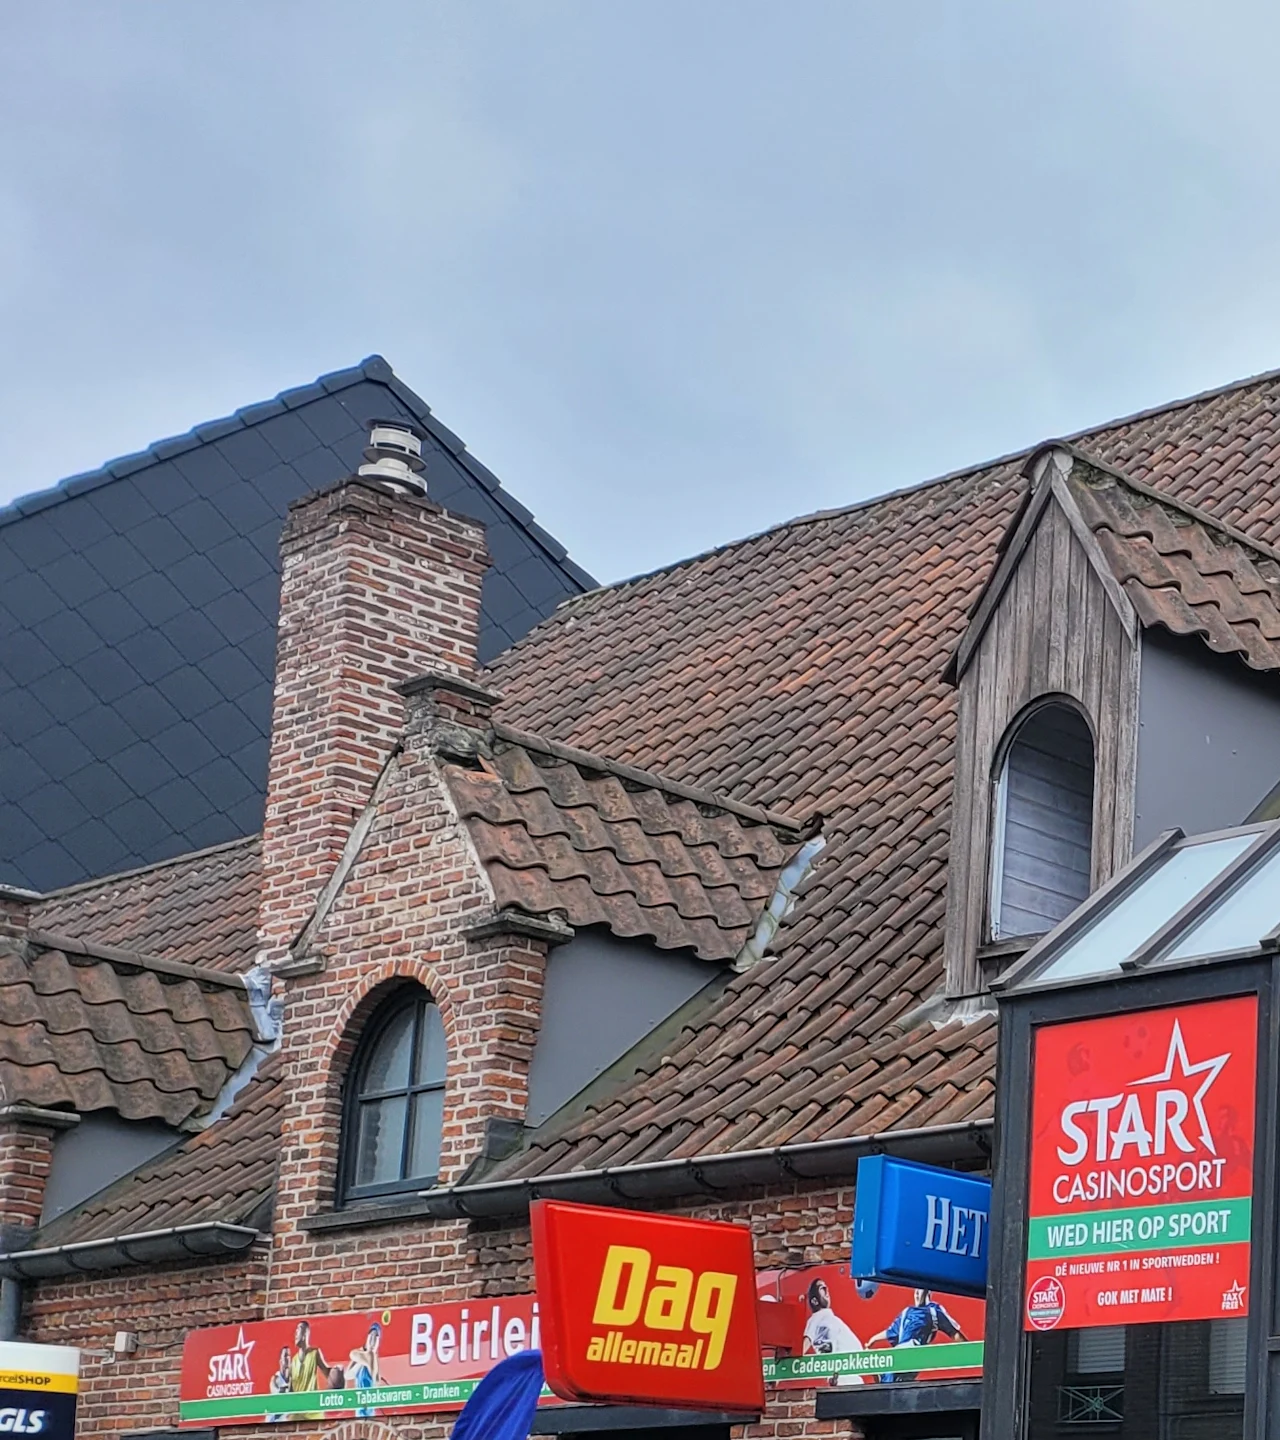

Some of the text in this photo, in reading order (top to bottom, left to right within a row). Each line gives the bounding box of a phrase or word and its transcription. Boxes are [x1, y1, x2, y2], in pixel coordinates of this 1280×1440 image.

[1056, 1089, 1215, 1166] STAR
[1052, 1158, 1227, 1204] CASINOSPORT
[1047, 1210, 1231, 1249] WED HIER OP SPORT
[1069, 1253, 1214, 1276] NIEUWE NR SPORTWEDDEN
[592, 1244, 738, 1371] Dag
[1033, 1291, 1055, 1303] STAR
[1097, 1287, 1166, 1306] GOK MET MATE
[411, 1303, 541, 1367] Beirlei
[586, 1333, 703, 1370] allemaal
[791, 1353, 893, 1375] Cadeaupakketten
[208, 1353, 250, 1382] STAR
[206, 1382, 254, 1397] CASINOSPORT
[319, 1393, 344, 1407] Lotto
[357, 1389, 412, 1404] Tabakswaren
[423, 1387, 460, 1399] Dranken
[0, 1407, 46, 1433] GLS
